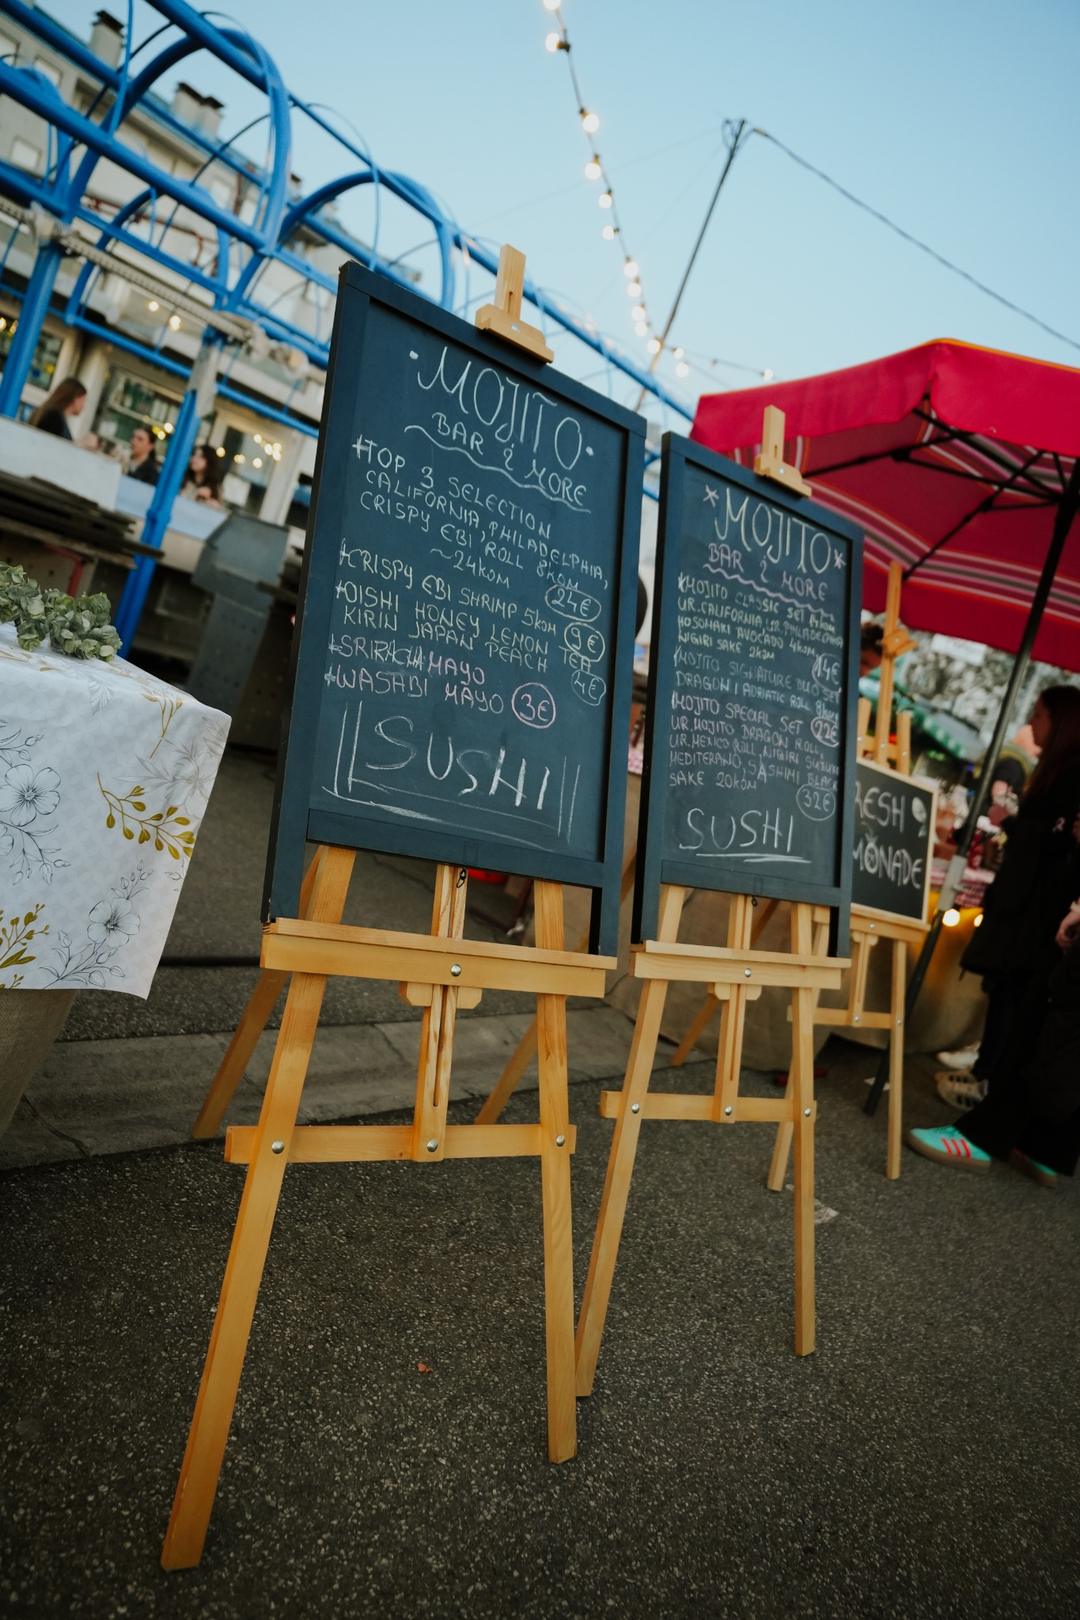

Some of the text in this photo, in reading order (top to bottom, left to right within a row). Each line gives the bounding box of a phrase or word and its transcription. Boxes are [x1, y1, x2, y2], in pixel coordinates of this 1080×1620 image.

[417, 346, 582, 470] MOJITO
[432, 412, 483, 455] BAR
[525, 459, 587, 506] MORE
[364, 438, 551, 539] TOP 3 SELECTION
[360, 491, 431, 533] CRISPY
[440, 523, 472, 549] EBI
[484, 541, 524, 570] ROLL
[715, 487, 832, 575] MOJITO
[708, 542, 745, 574] BAR
[782, 570, 828, 601] MORE
[347, 549, 414, 589] CRISPY
[421, 574, 451, 601] EBI
[458, 587, 518, 619] SHRIMP
[571, 626, 599, 653] 9€
[551, 587, 593, 617] 24€
[686, 575, 728, 600] MOJITO
[734, 592, 780, 614] CLASSIC
[344, 581, 592, 673] OISHI HONEY LEMON TEA
[677, 615, 731, 635] HOSOMAKI
[736, 626, 785, 649] AVOCADO
[678, 630, 713, 648] NIGIRI
[716, 638, 742, 654] SAKE
[343, 604, 600, 701] KIRIN JAPAN PEACH 4€
[427, 651, 486, 686] MAYO
[680, 649, 720, 673] MOJITO
[335, 663, 551, 722] WASABI MAYO 3€
[675, 670, 731, 693] DRAGON
[742, 682, 785, 705] ADRIATIC
[675, 692, 804, 736] MOJITO SPECIAL SET
[740, 724, 789, 750] DRAGON
[366, 716, 550, 811] SUSHI
[669, 770, 705, 787] SAKE
[748, 758, 800, 785] SASHIMI
[801, 788, 830, 812] 32€
[679, 808, 794, 853] SUSHI
